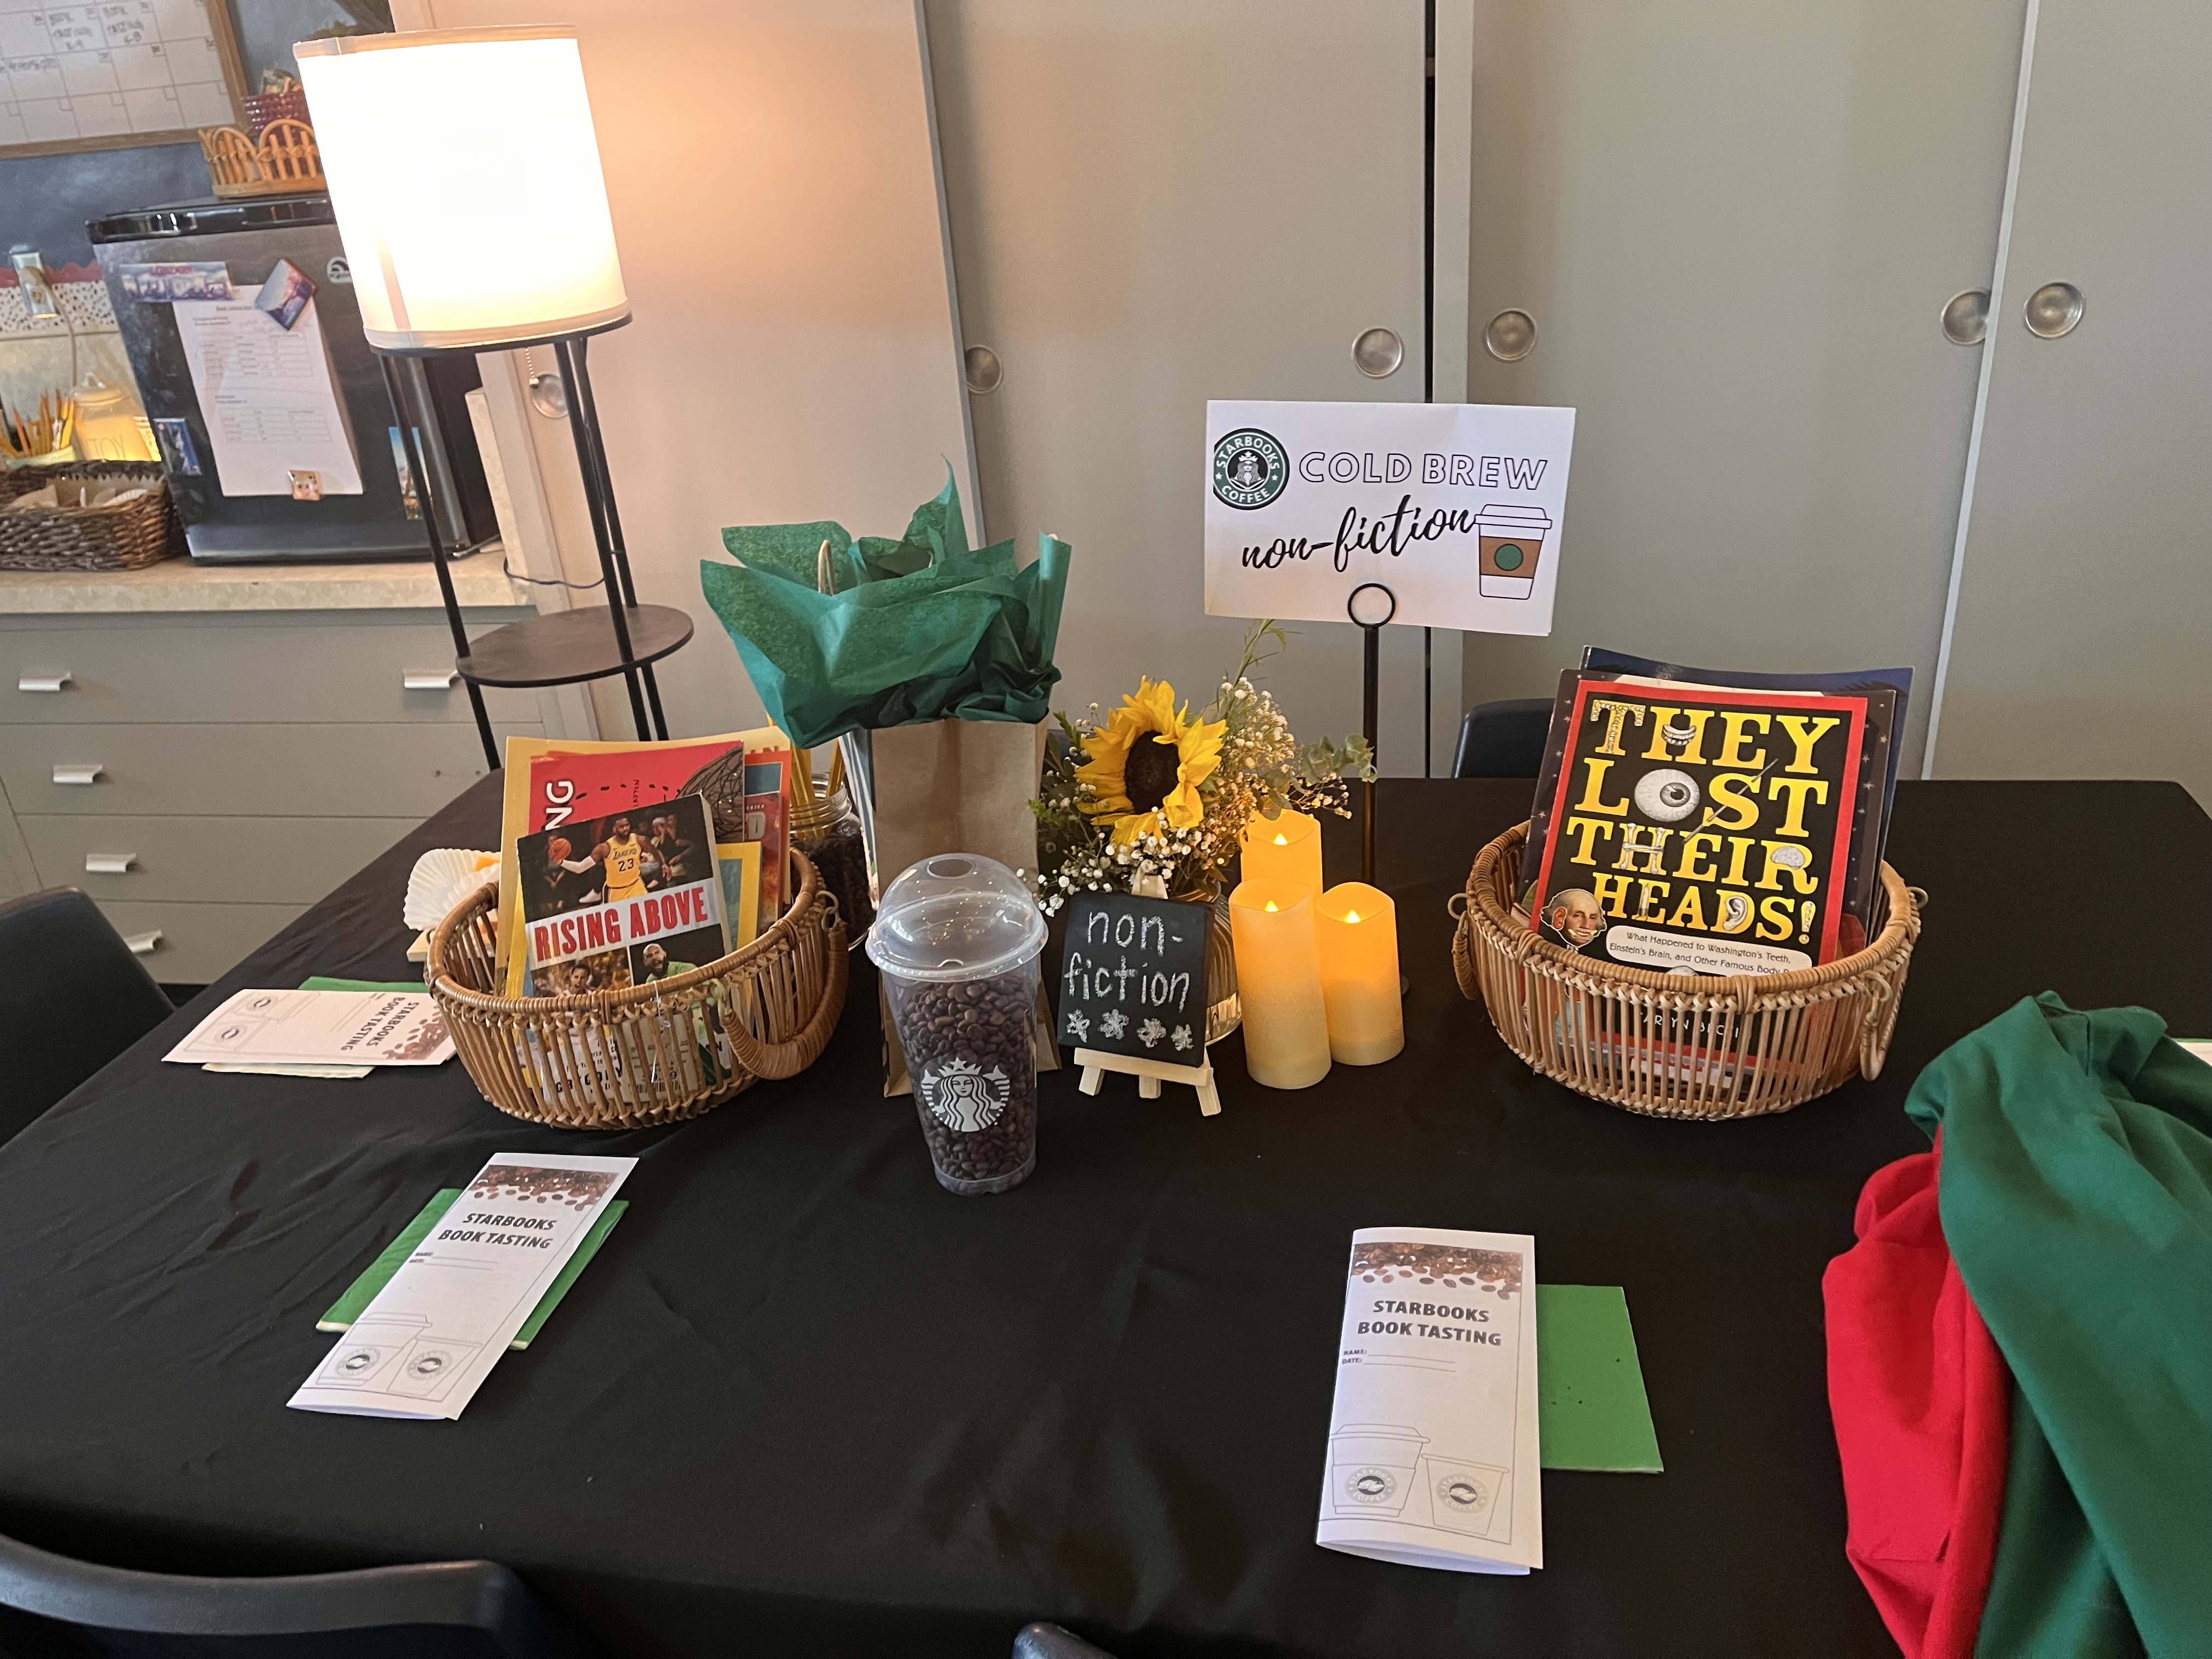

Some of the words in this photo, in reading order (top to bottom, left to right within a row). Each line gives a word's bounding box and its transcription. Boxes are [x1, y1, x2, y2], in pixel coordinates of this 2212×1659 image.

[1216, 436, 1280, 470] STARBOOKS
[1299, 452, 1412, 483] COLD
[1422, 453, 1548, 490] BREW
[1222, 485, 1270, 503] COFFEE
[1241, 494, 1478, 572] non-fiction
[1590, 698, 1840, 774] THEY
[618, 858, 634, 872] 23
[1565, 816, 1820, 895] THEIR
[534, 908, 622, 962] RISING
[630, 887, 708, 939] ABOVE
[1592, 871, 1817, 944] HEADS!
[1087, 911, 1184, 957] non-
[1626, 932, 1647, 943] What
[1650, 935, 1694, 949] Happened
[1696, 943, 1705, 951] to
[1708, 944, 1763, 959] Washington's
[1766, 952, 1791, 964] Teeth,
[1609, 943, 1646, 955] Einstein's
[1649, 949, 1672, 960] Brain,
[1674, 954, 1692, 962] and
[1694, 955, 1718, 966] Other
[1720, 959, 1754, 972] Famous
[1064, 952, 1190, 1013] fiction
[366, 996, 420, 1046] STARBOOKS
[375, 997, 406, 1016] BOOK
[340, 1017, 383, 1051] TASTING
[462, 1212, 557, 1231] STARBOOKS
[438, 1229, 487, 1243] BOOK
[486, 1232, 554, 1249] TASTING
[1373, 1300, 1490, 1323] STARBOOKS
[1357, 1321, 1414, 1336] BOOK
[1417, 1323, 1502, 1346] TASTING
